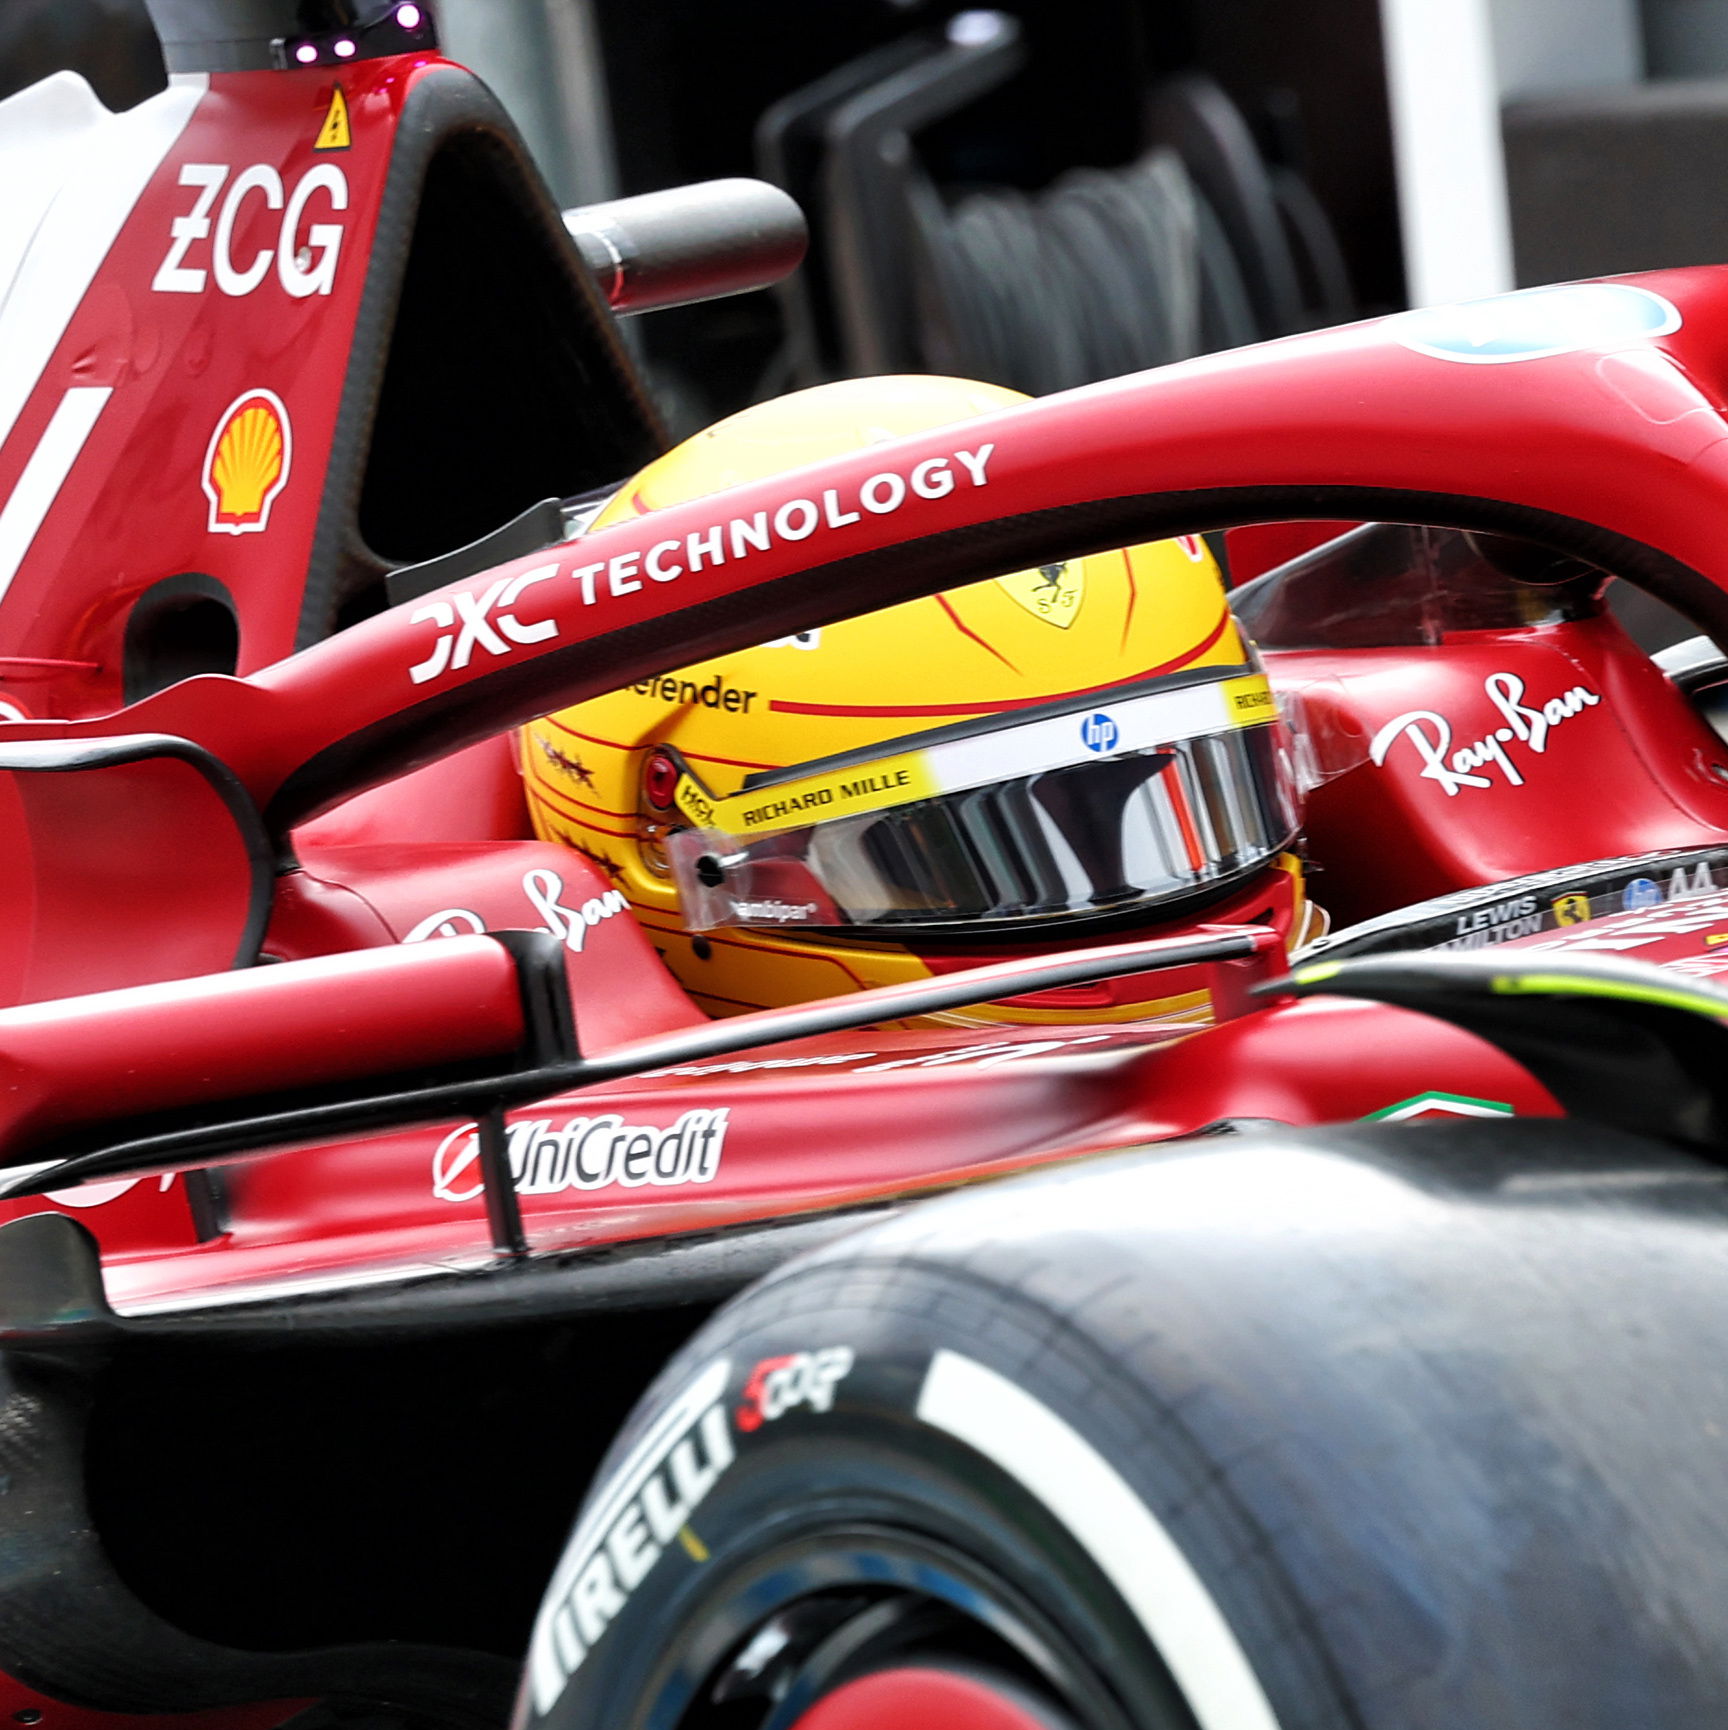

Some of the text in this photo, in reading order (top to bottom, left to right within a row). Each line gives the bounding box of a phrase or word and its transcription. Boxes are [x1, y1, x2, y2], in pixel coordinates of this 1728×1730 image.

[409, 443, 996, 685] DXC TECHNOLOGY
[625, 674, 758, 714] efender
[1086, 714, 1115, 752] hp
[742, 769, 912, 828] RICHARD MILLE
[1456, 895, 1538, 936] LEWIS
